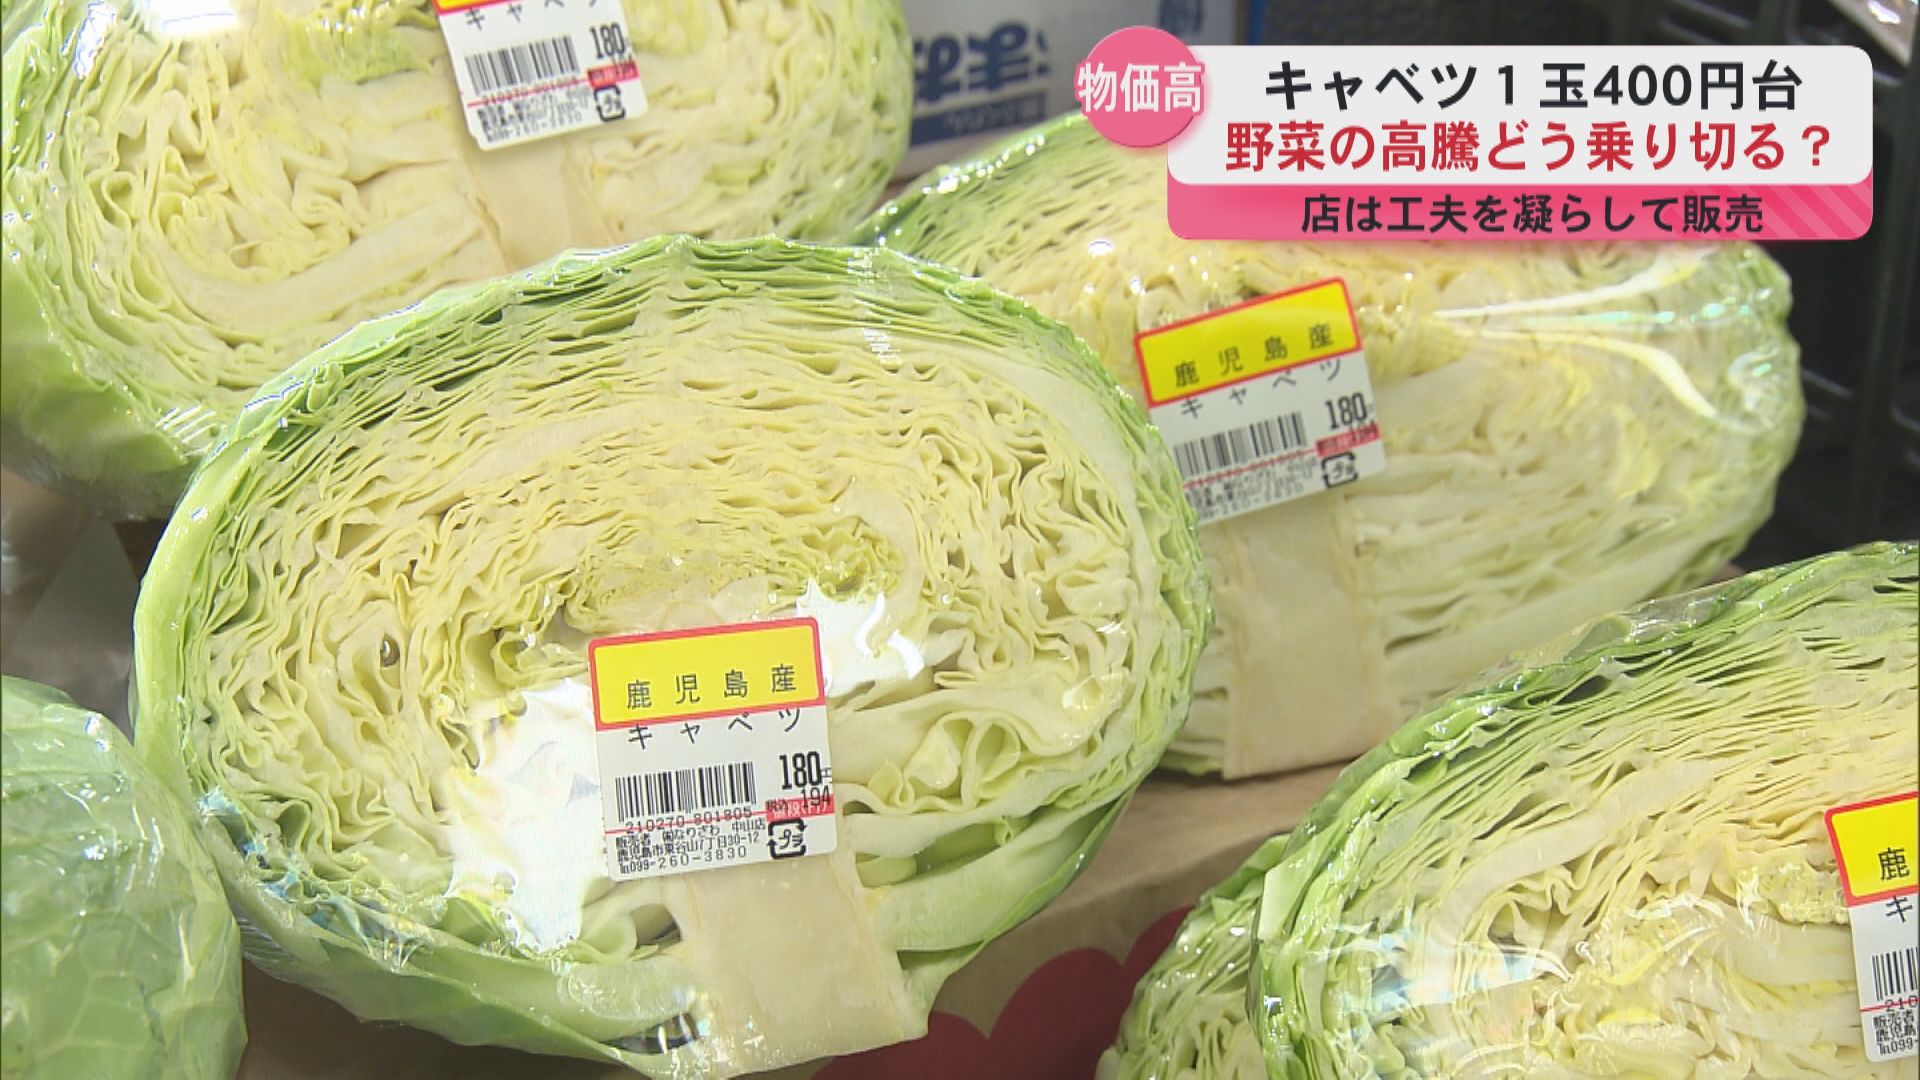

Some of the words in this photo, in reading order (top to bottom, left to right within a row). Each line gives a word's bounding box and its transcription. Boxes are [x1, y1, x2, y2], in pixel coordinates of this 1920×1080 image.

[589, 21, 625, 59] 180
[1174, 322, 1333, 388] 鹿児島産
[1324, 391, 1368, 431] 180
[627, 663, 797, 711] 鹿児島産
[1877, 846, 1910, 881] 鹿
